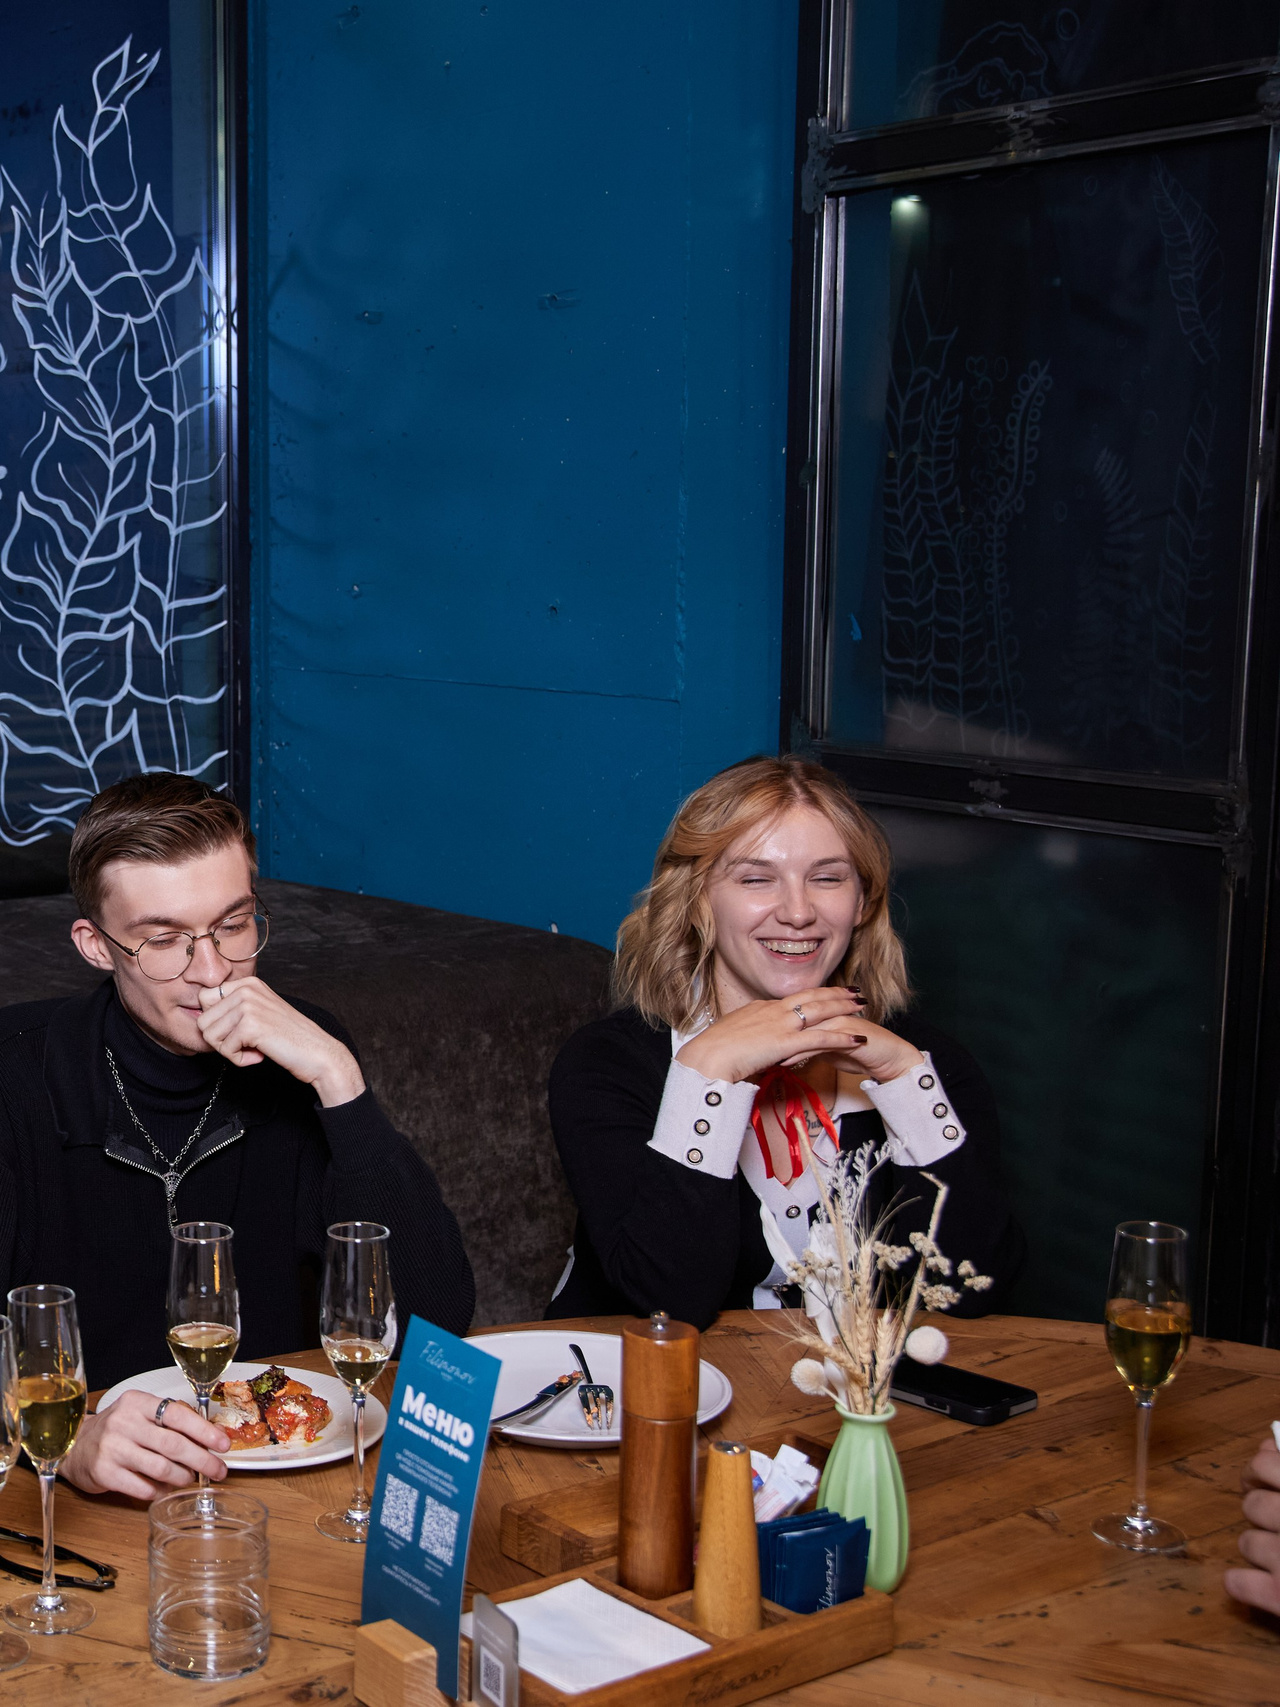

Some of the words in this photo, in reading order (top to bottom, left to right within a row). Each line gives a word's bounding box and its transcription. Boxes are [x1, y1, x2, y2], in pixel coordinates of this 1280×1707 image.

[419, 1340, 478, 1385] Filimonov
[401, 1384, 475, 1448] Меню
[404, 1419, 431, 1441] вашем
[430, 1434, 471, 1463] телефоне
